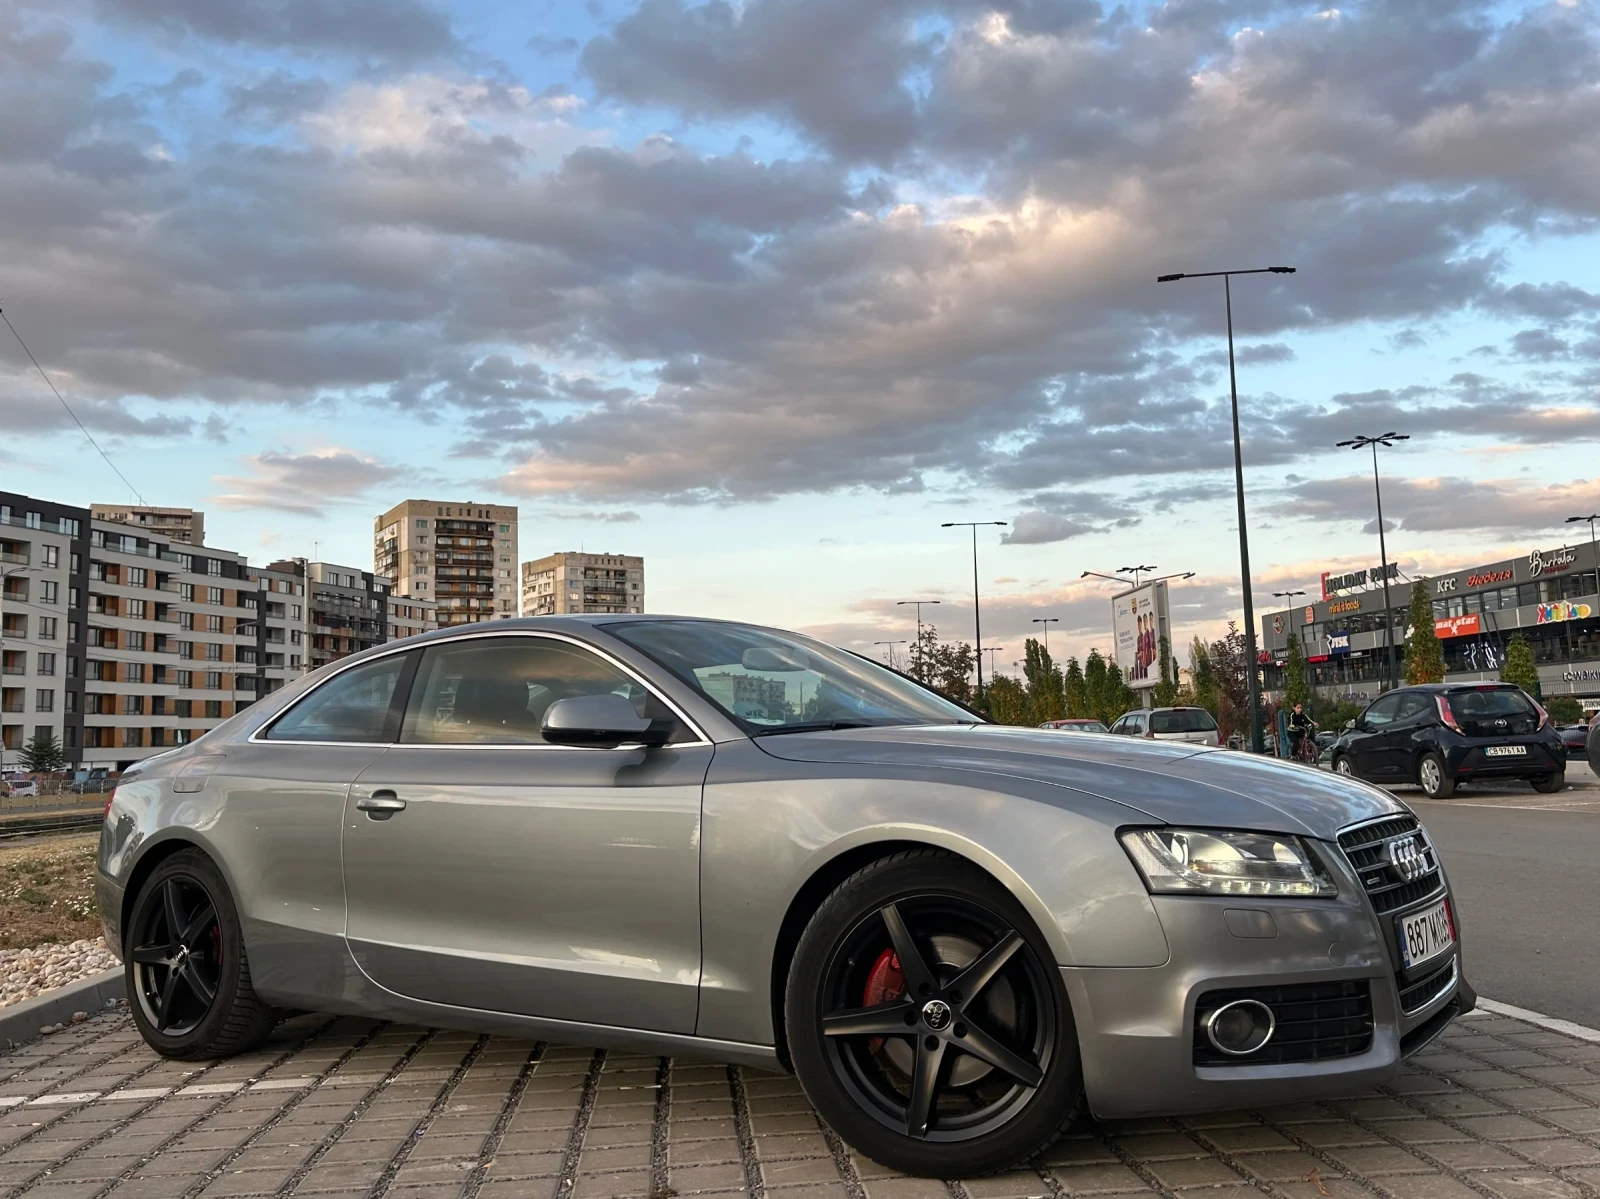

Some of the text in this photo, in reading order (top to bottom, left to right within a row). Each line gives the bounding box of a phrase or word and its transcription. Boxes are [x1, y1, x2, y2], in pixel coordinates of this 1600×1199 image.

[1529, 546, 1575, 578] Burrata
[1326, 570, 1366, 594] HOLIDAY
[1437, 578, 1456, 593] KFC
[1466, 570, 1511, 587] Неделя
[1436, 616, 1476, 630] mat star
[1407, 917, 1429, 959] 887
